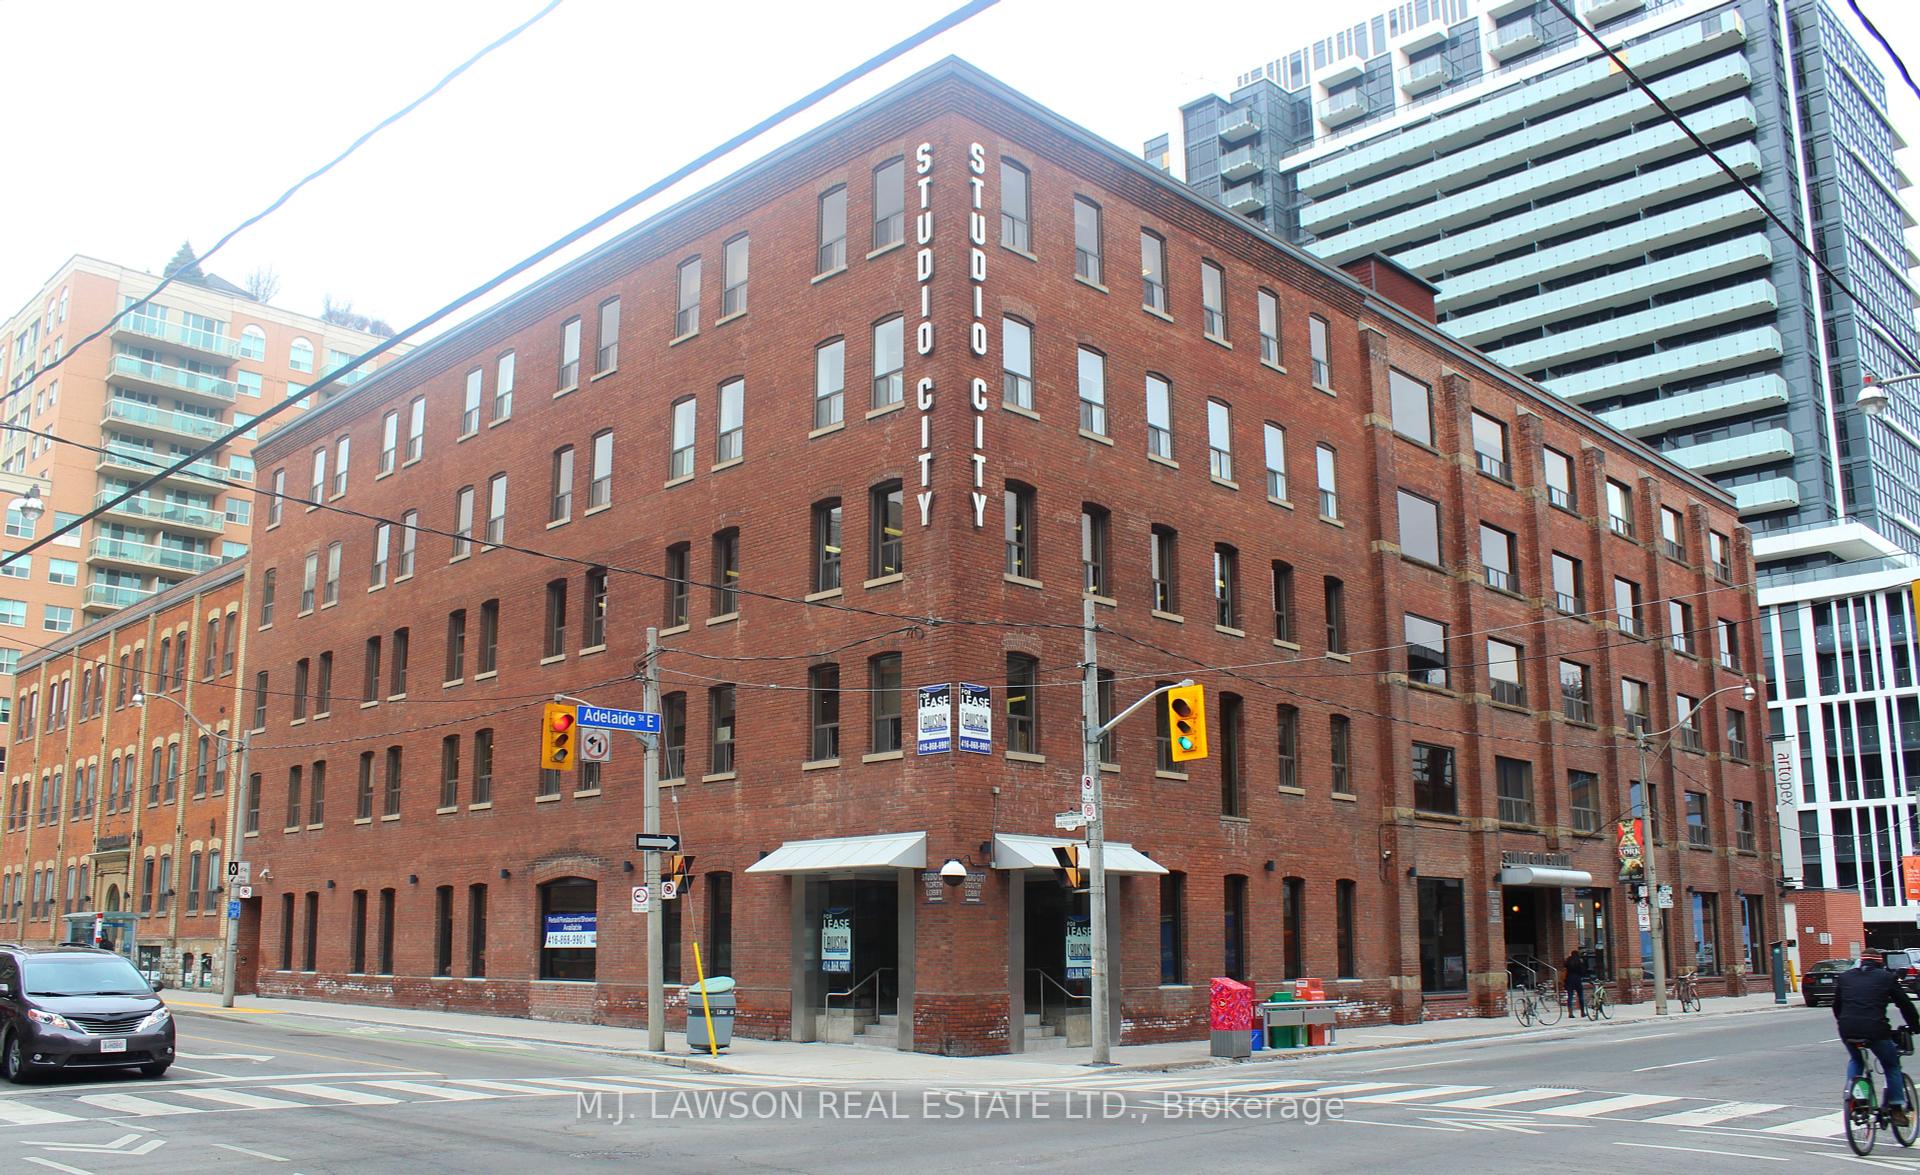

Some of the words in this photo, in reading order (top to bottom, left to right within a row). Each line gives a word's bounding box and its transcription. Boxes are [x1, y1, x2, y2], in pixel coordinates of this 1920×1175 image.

[916, 142, 935, 357] STUDIO
[969, 142, 988, 357] STUDIO
[916, 377, 935, 528] CITY
[970, 377, 988, 529] CITY
[584, 708, 636, 726] Adelaide
[647, 715, 654, 728] E
[920, 695, 949, 708] LEASE
[961, 694, 990, 708] LEASE
[1777, 753, 1793, 806] artopex
[823, 919, 850, 929] LEASE
